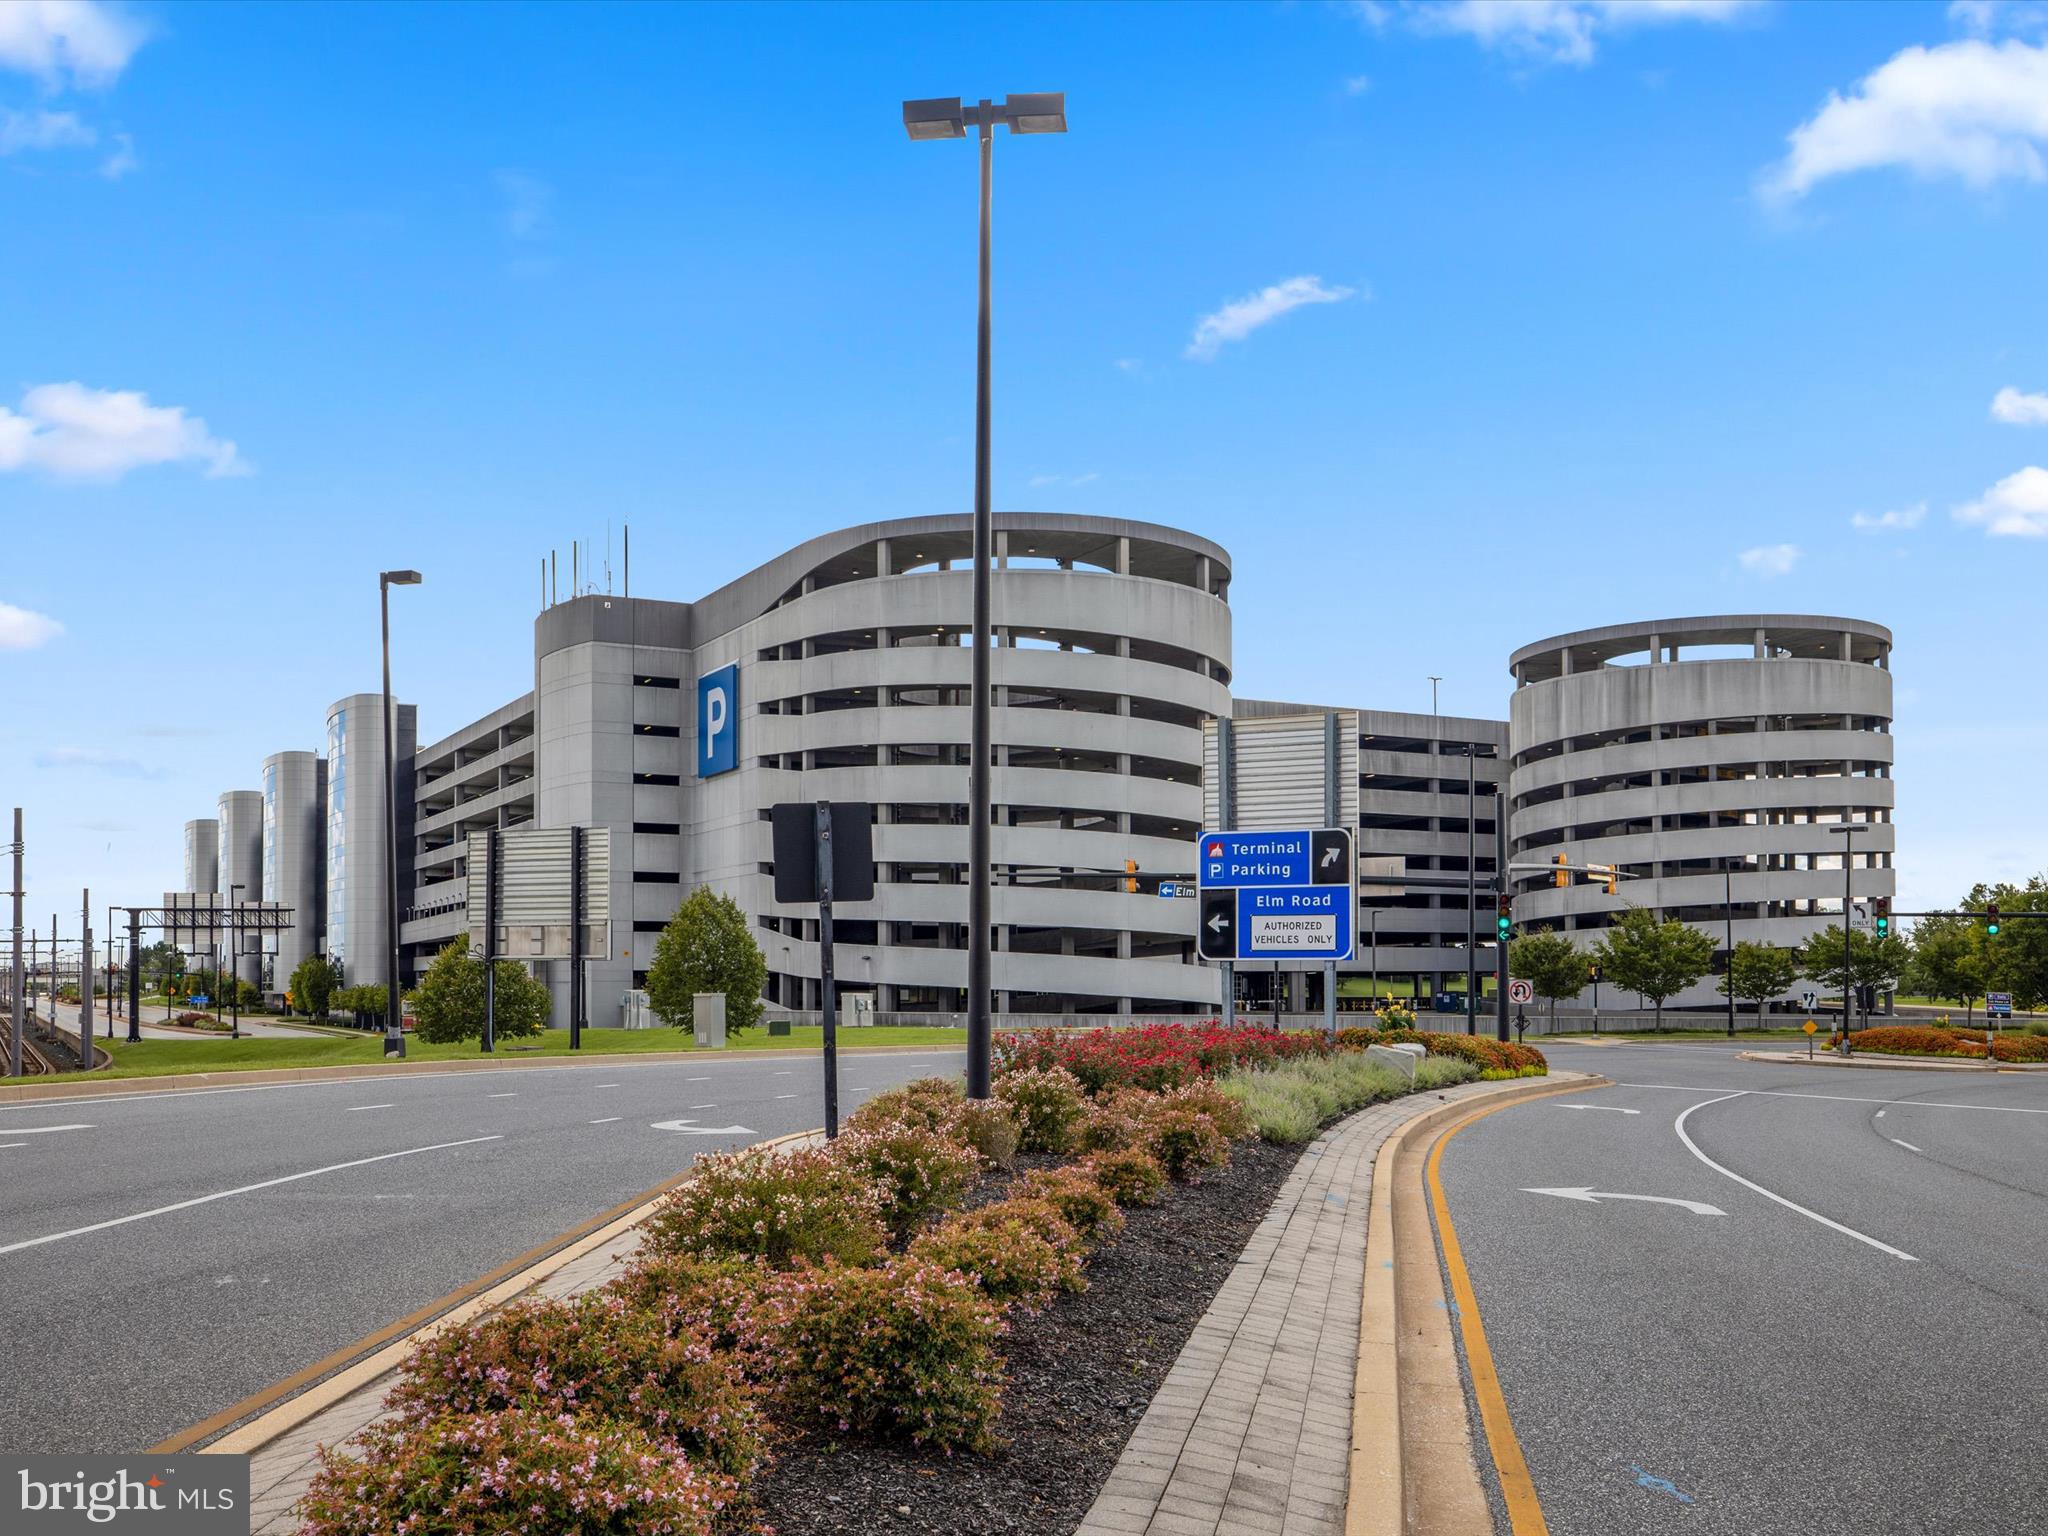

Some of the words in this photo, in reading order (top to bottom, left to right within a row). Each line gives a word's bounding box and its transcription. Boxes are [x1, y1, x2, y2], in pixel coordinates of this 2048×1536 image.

[708, 687, 726, 759] P
[1232, 841, 1301, 855] Terminal
[1210, 864, 1221, 877] P
[1231, 863, 1291, 878] Parking
[1176, 887, 1195, 896] Elm
[1256, 895, 1284, 907] Elm
[1291, 894, 1331, 907] Road
[1264, 921, 1323, 930] AUTHORIZED
[1254, 935, 1300, 944] VEHICLES
[1307, 935, 1333, 944] ONLY
